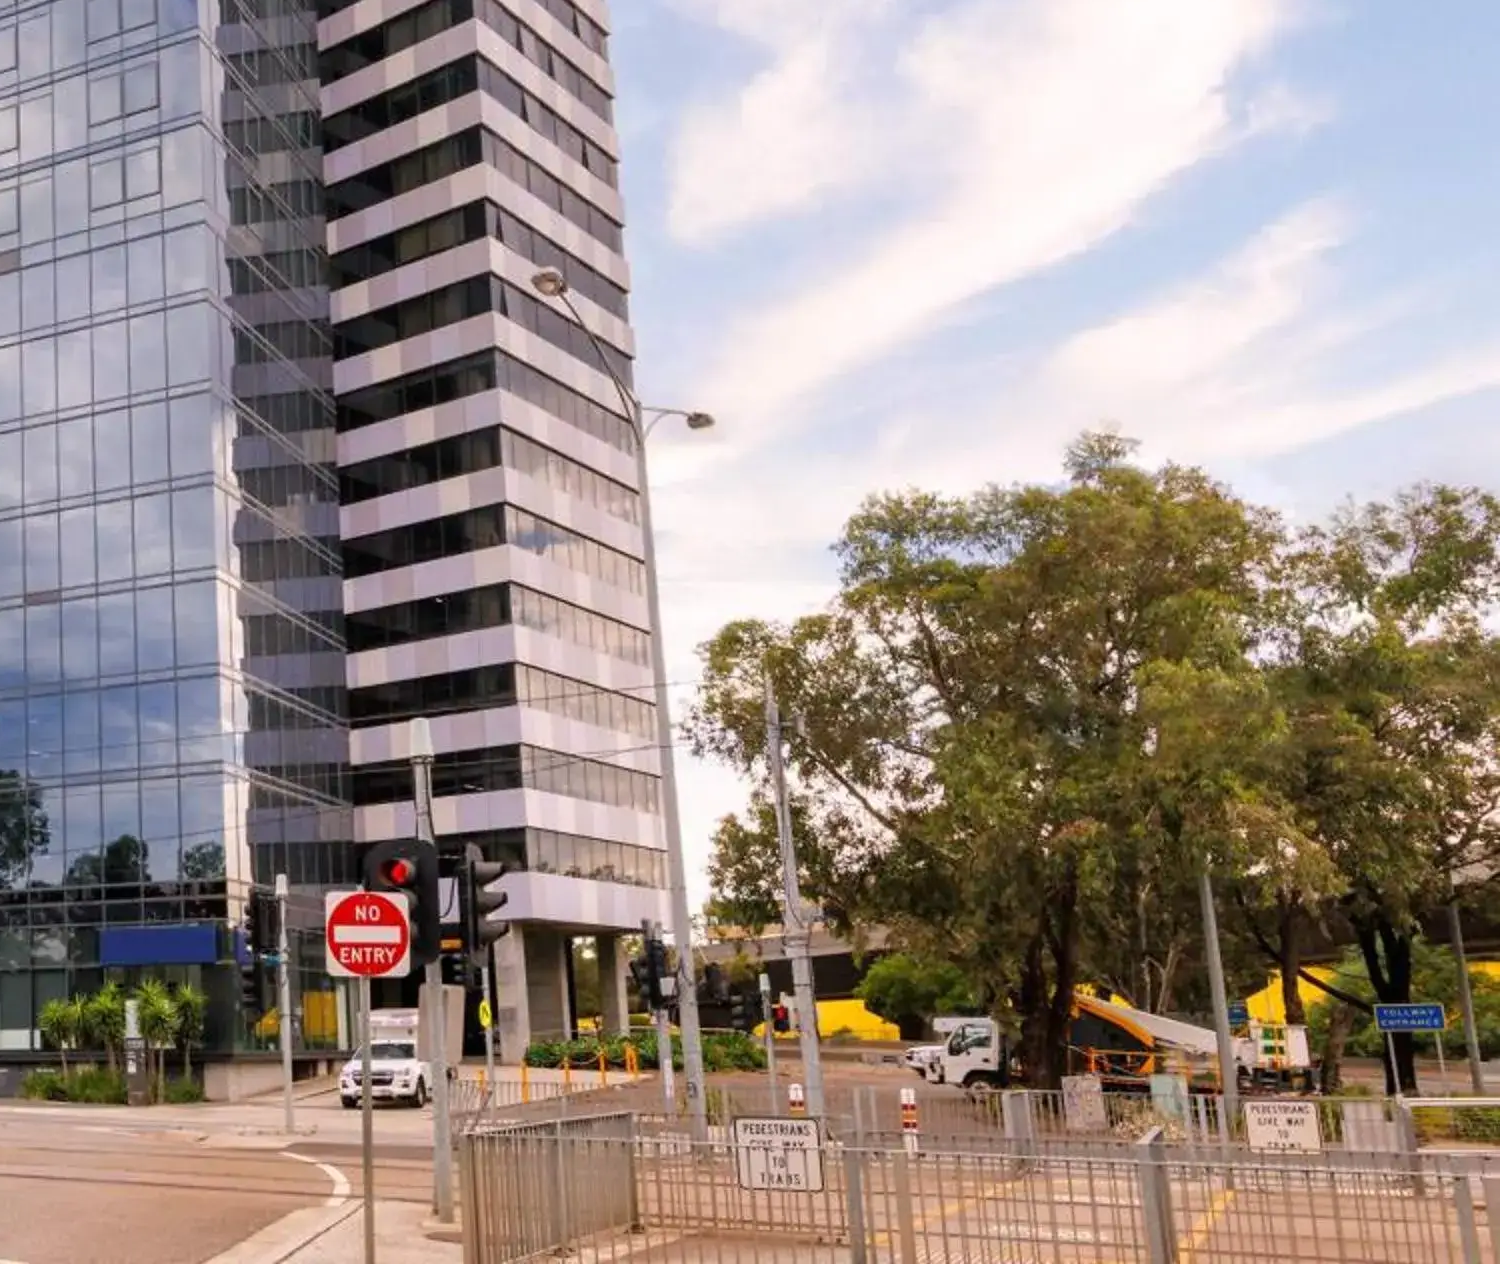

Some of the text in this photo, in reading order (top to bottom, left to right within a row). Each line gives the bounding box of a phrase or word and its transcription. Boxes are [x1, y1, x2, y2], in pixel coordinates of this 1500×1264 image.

[355, 904, 381, 922] NO
[340, 947, 397, 964] ENTRY
[1286, 1117, 1305, 1127] WAY
[742, 1123, 811, 1136] PEDESTRIANS
[772, 1156, 788, 1169] TO
